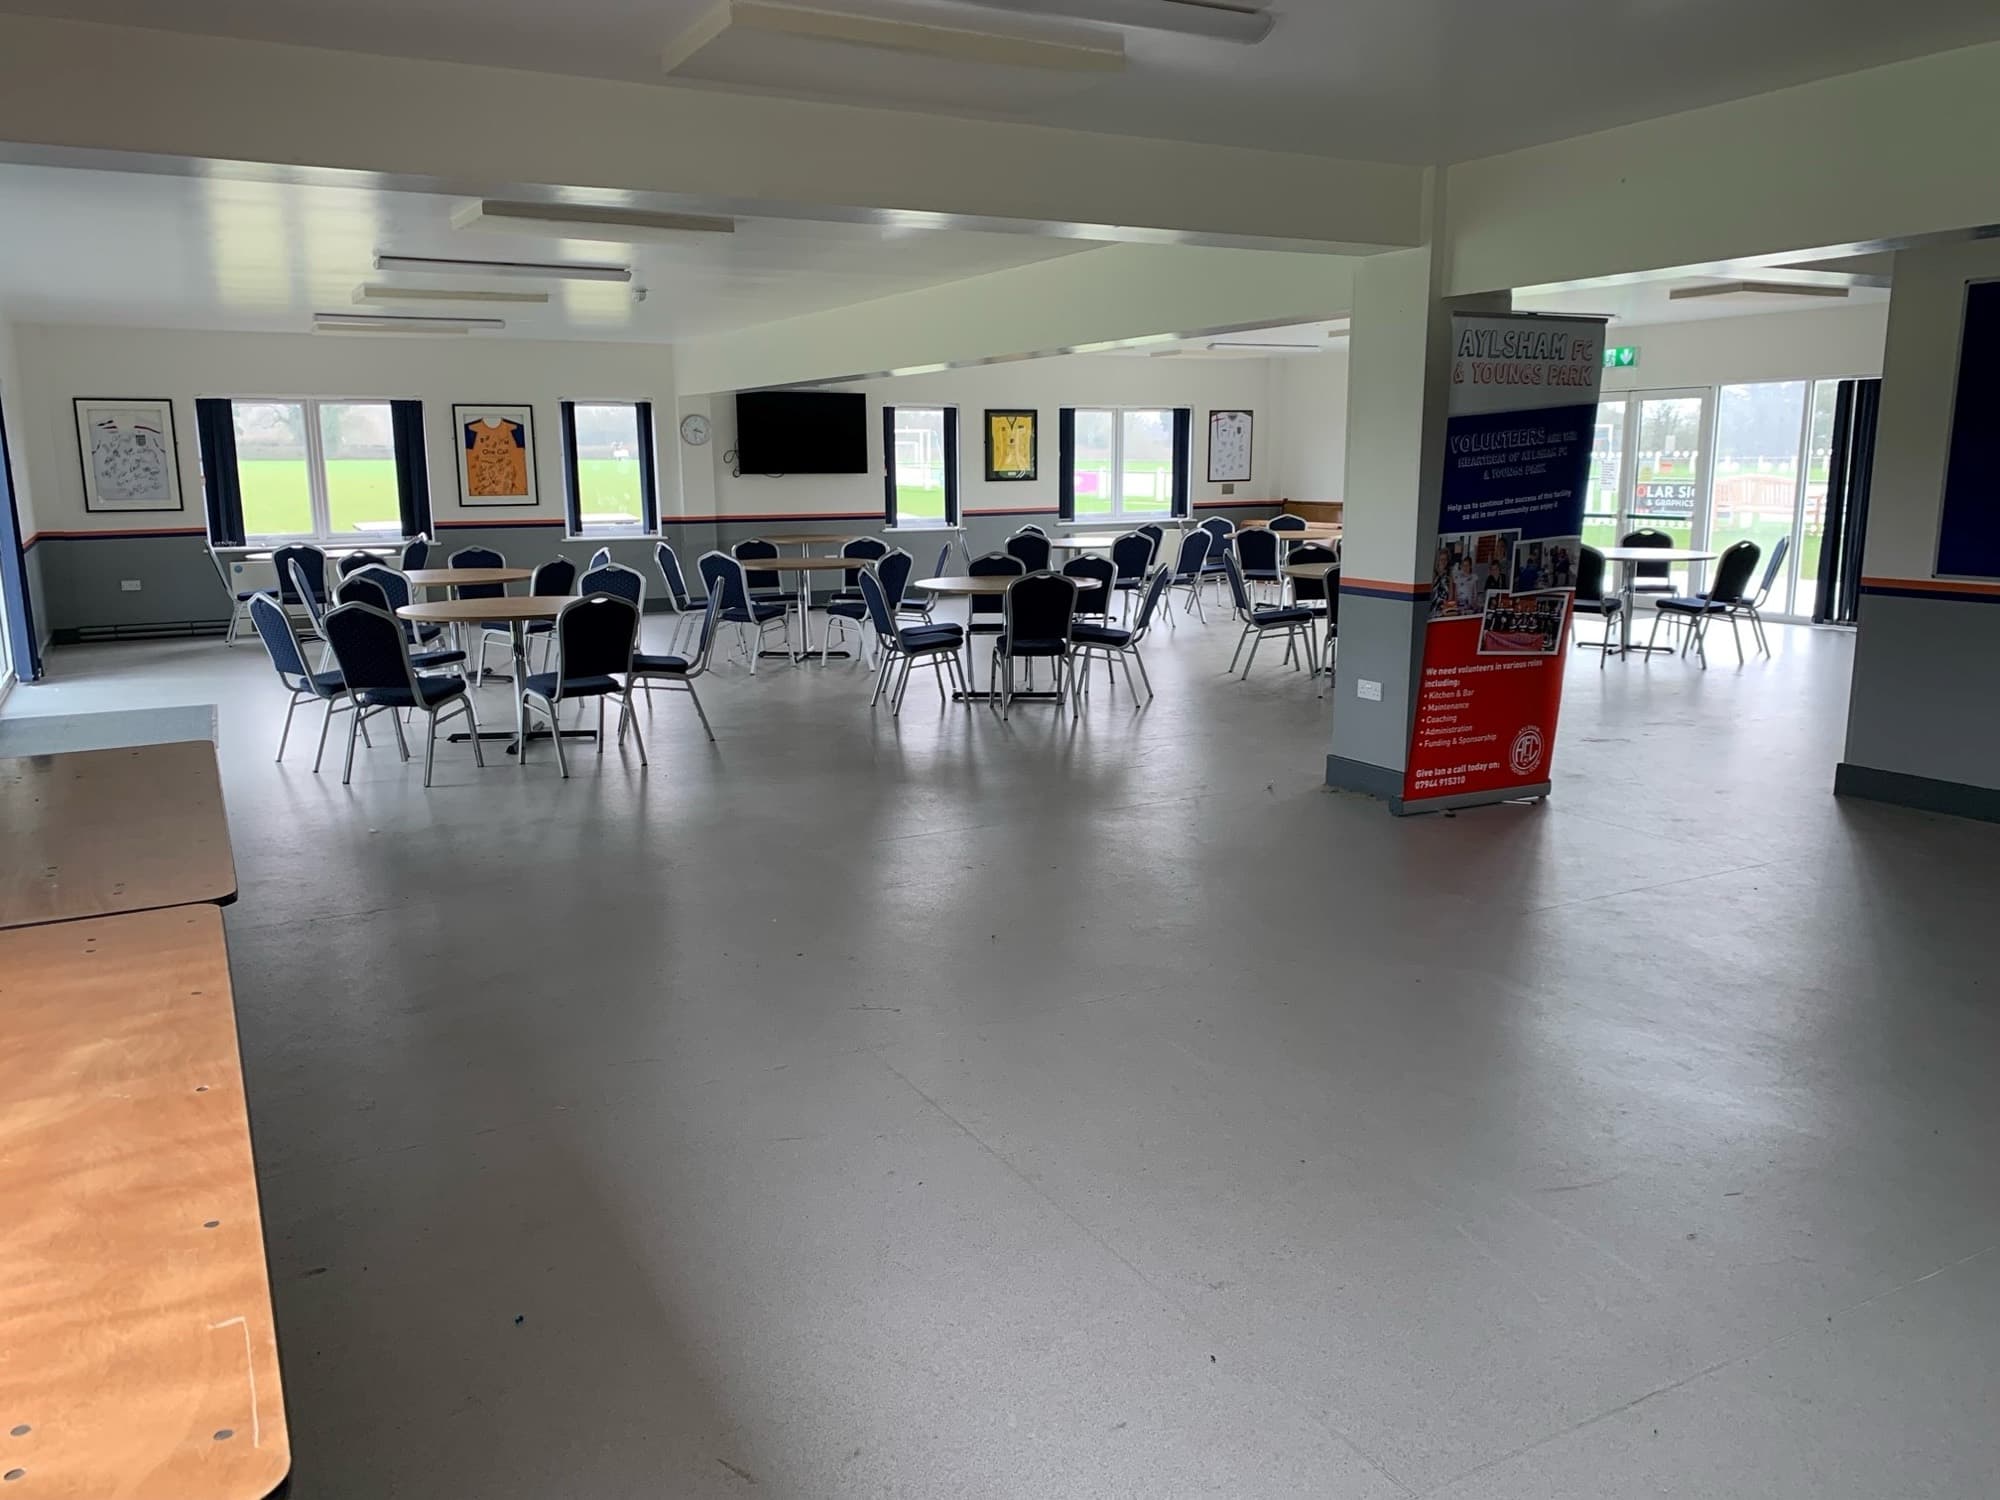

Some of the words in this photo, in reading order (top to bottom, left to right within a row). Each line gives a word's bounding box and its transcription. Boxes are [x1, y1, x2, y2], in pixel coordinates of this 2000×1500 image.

[1458, 329, 1569, 361] AYLSHAM
[1571, 339, 1593, 361] FC
[1453, 361, 1464, 385] &
[1472, 361, 1541, 385] YOUNGS
[1547, 364, 1593, 386] PARK
[1450, 426, 1545, 454] VOLUNTEERS
[1458, 454, 1507, 468] HEARTBEAT
[1509, 452, 1519, 462] OF
[1636, 485, 1674, 498] OLAR
[1447, 504, 1462, 513] Help
[1479, 499, 1504, 508] continue
[1504, 497, 1514, 505] the
[1553, 489, 1572, 498] facility
[1655, 499, 1695, 508] GRAPHICS
[1498, 505, 1530, 517] community
[1529, 503, 1540, 512] can
[1540, 502, 1553, 511] enjoy
[1426, 667, 1438, 676] We
[1438, 666, 1457, 675] need
[1458, 663, 1494, 674] volunteers
[1495, 662, 1502, 670] in
[1503, 660, 1527, 670] various
[1527, 659, 1543, 667] roles
[1425, 678, 1461, 688] including:
[1428, 690, 1455, 700] Kitchen
[1456, 689, 1462, 697] &
[1463, 688, 1474, 697] Bar
[1427, 702, 1470, 712] Maintenance
[1426, 714, 1457, 724] Coaching
[1424, 725, 1473, 736] Administration
[1424, 737, 1451, 748] Funding
[1452, 736, 1458, 745] &
[1458, 733, 1497, 746] Sponsorship
[1416, 768, 1434, 778] Give
[1435, 767, 1447, 776] Ian
[1447, 767, 1453, 775] a
[1453, 764, 1467, 774] call
[1468, 762, 1488, 773] today
[1488, 762, 1501, 770] on:
[1415, 778, 1438, 790] 07944
